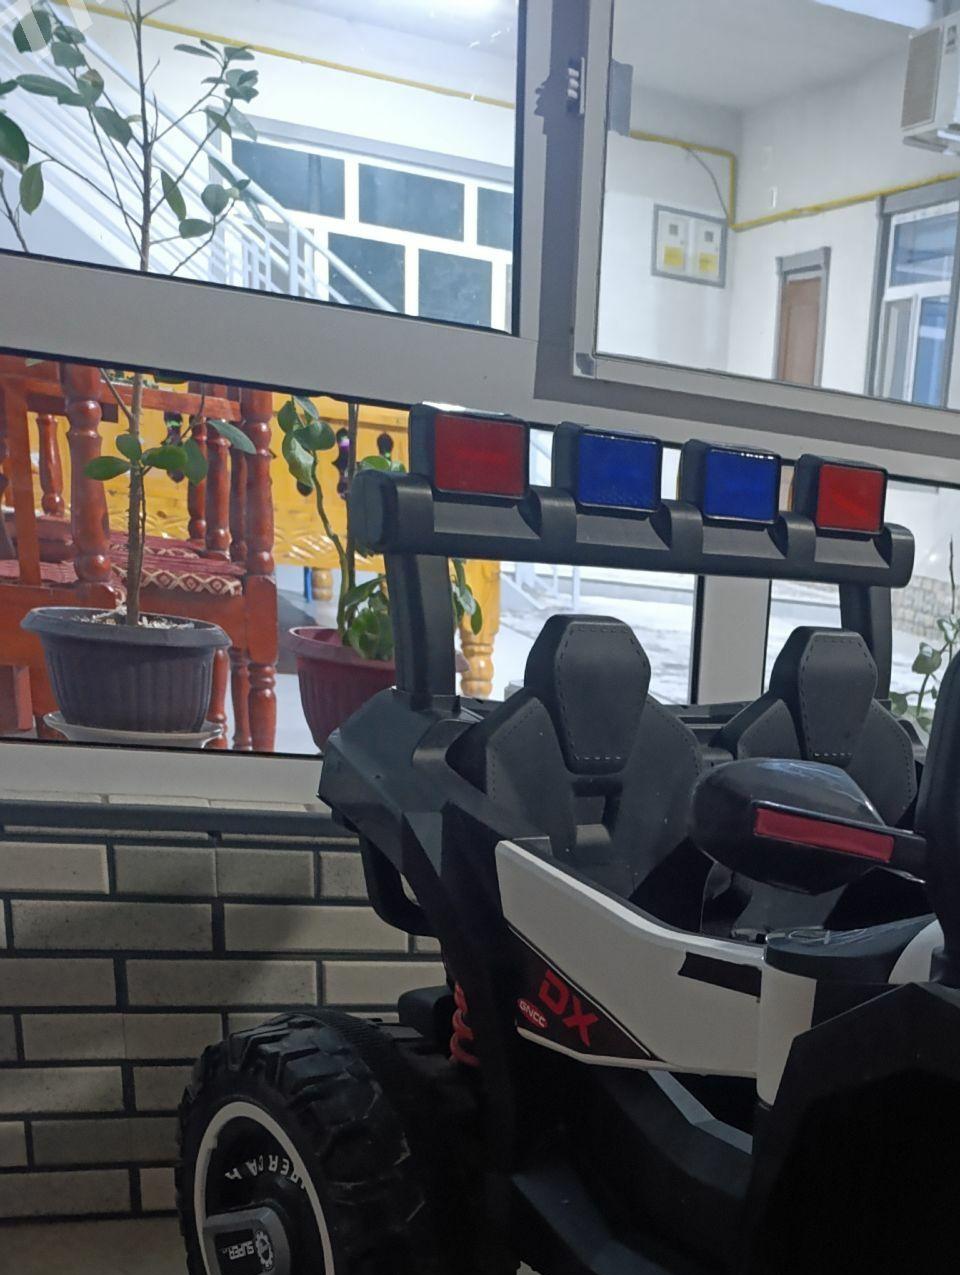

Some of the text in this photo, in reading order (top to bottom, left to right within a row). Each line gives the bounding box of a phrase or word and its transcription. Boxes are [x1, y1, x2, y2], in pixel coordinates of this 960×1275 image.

[519, 1000, 547, 1028] GNCC
[538, 969, 599, 1047] DX
[229, 1240, 255, 1260] SUPER
